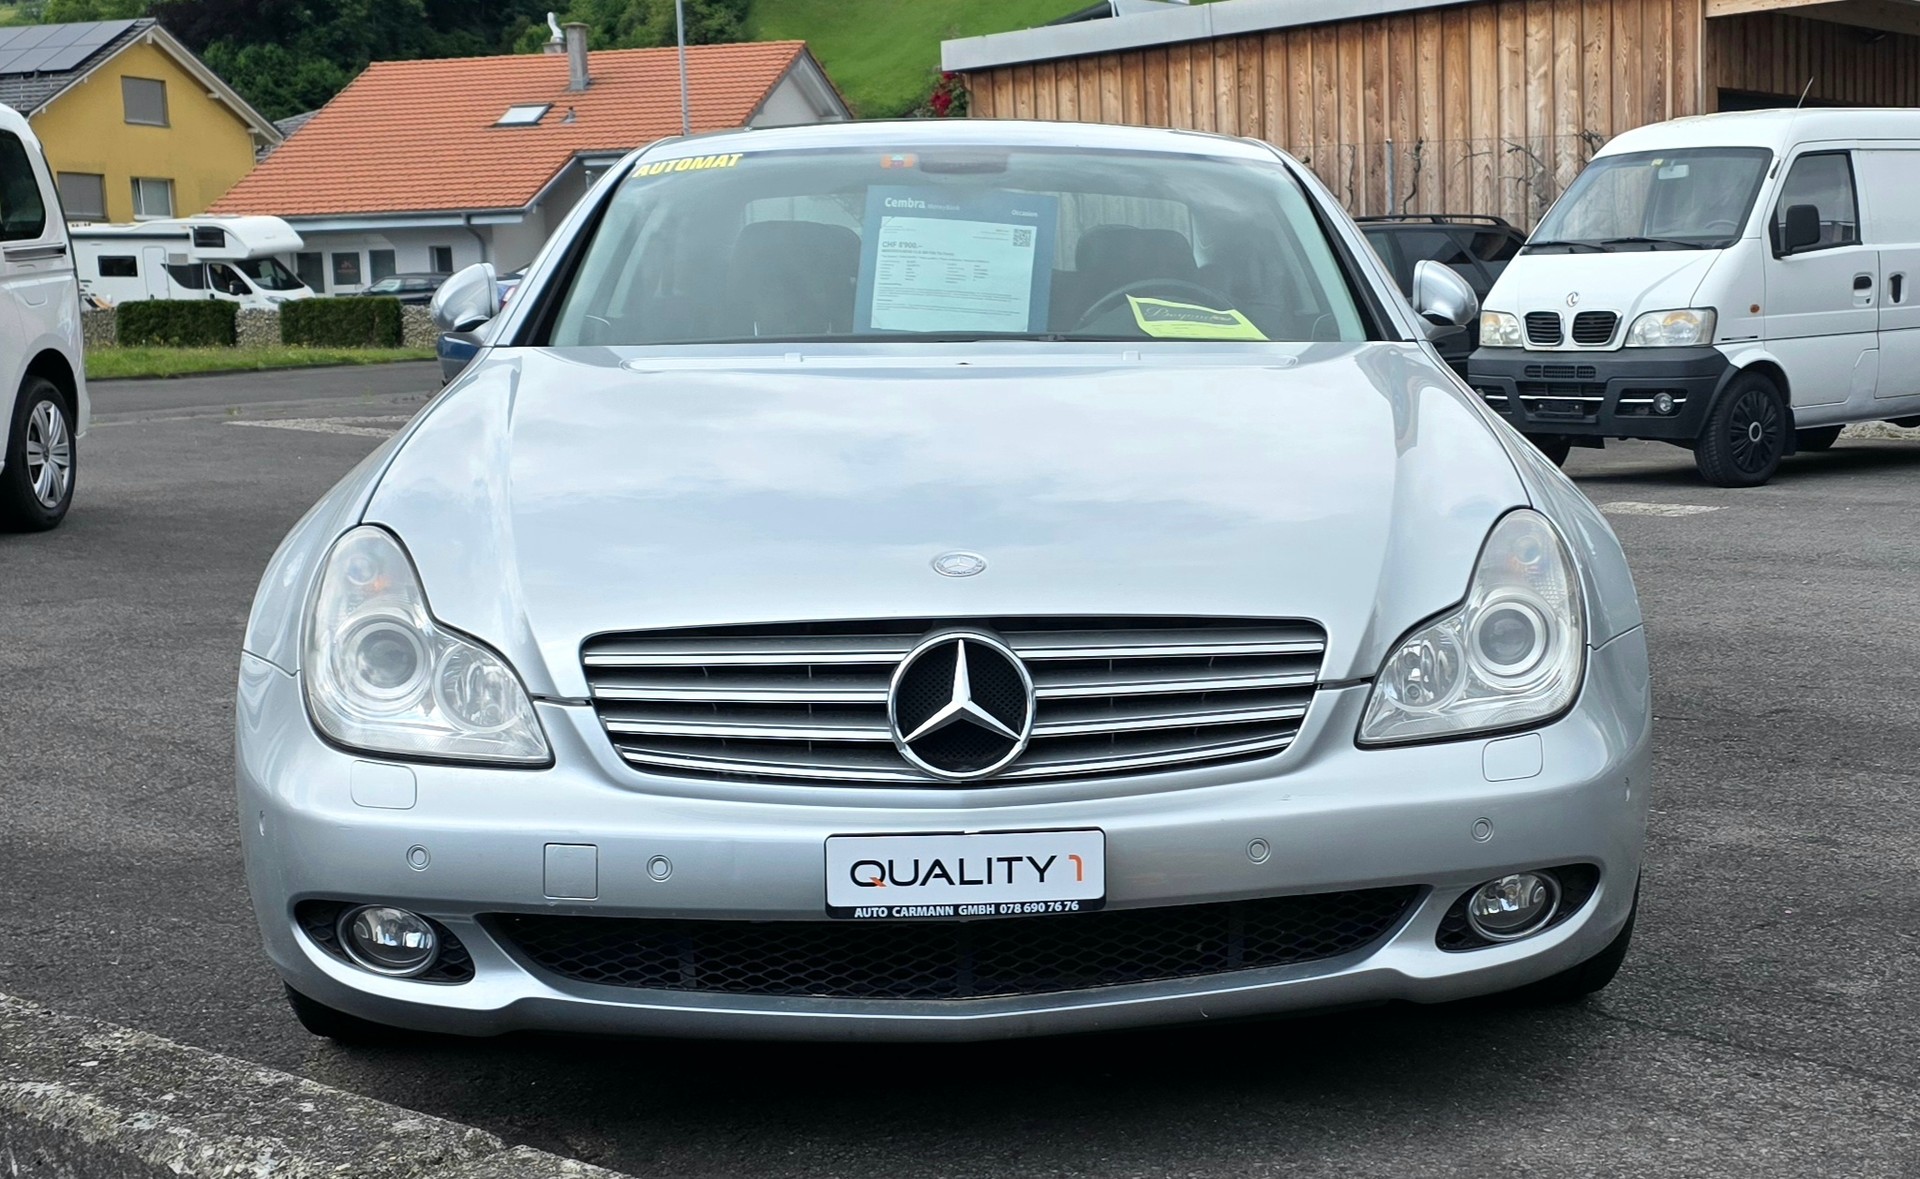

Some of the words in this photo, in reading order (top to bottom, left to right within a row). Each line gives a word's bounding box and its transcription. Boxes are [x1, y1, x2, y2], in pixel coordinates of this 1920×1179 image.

[633, 152, 743, 178] AUTOMAT
[884, 197, 926, 209] Cembra
[850, 855, 1057, 888] QUALITY
[1068, 854, 1083, 882] 1
[854, 906, 889, 918] AUTO
[892, 905, 954, 917] CARMANN
[958, 904, 995, 916] GMBH
[999, 902, 1022, 914] 078
[1023, 902, 1046, 913] 690
[1047, 901, 1063, 912] 76
[1064, 900, 1079, 911] 76
